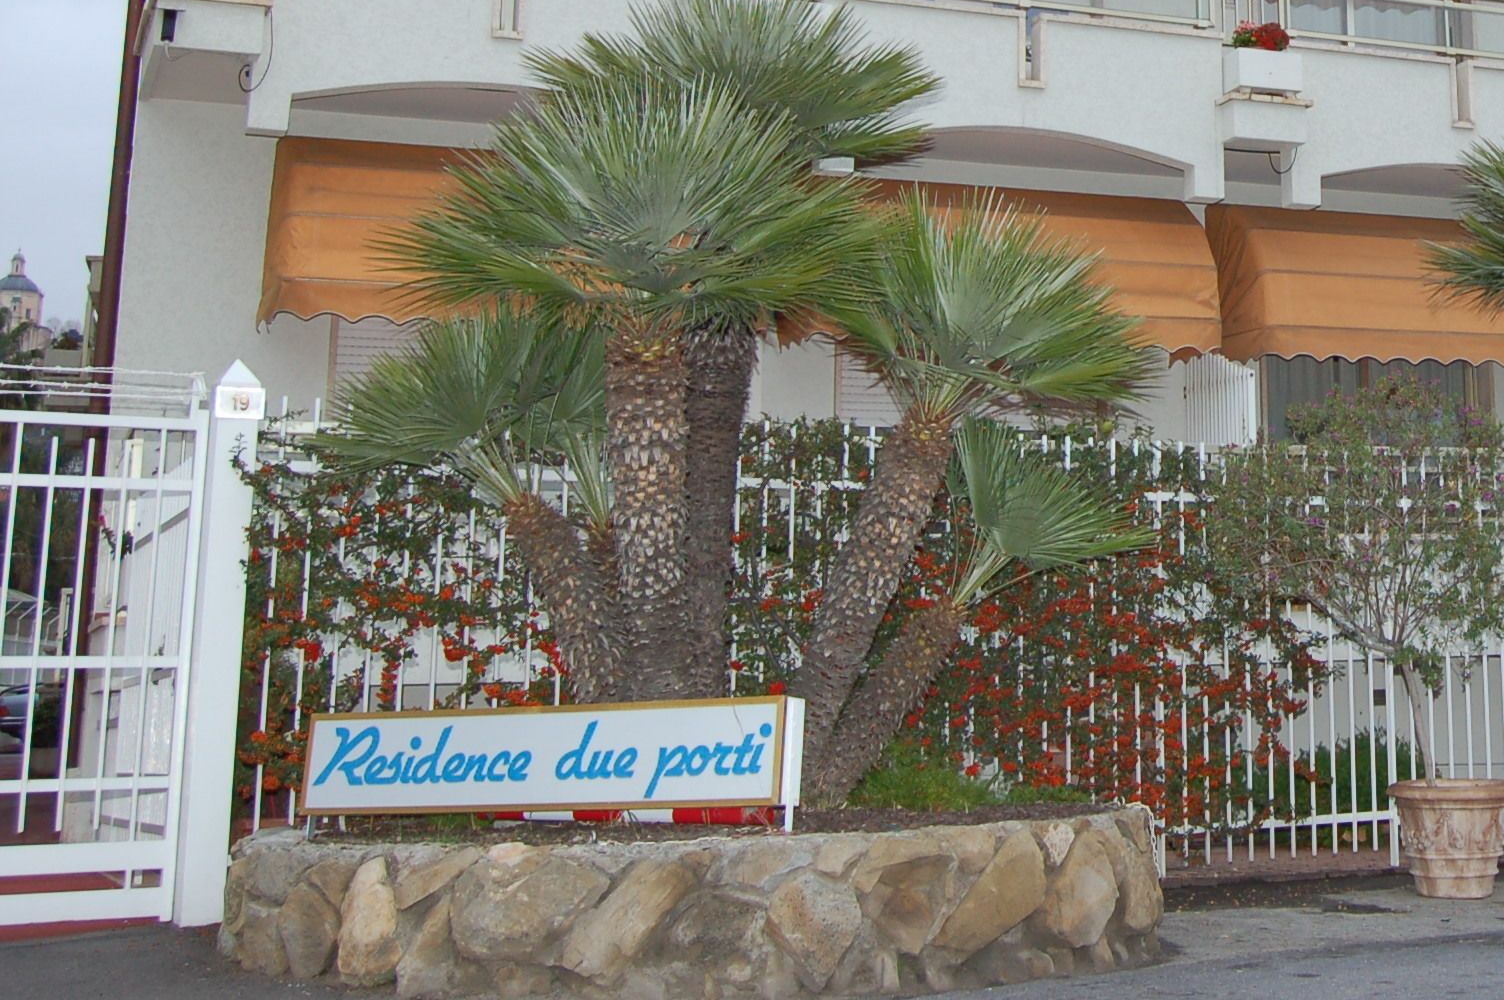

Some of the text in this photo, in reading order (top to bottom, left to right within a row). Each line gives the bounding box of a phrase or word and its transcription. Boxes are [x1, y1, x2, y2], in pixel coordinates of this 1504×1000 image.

[232, 393, 250, 411] 19
[312, 721, 774, 800] Residence due porti
